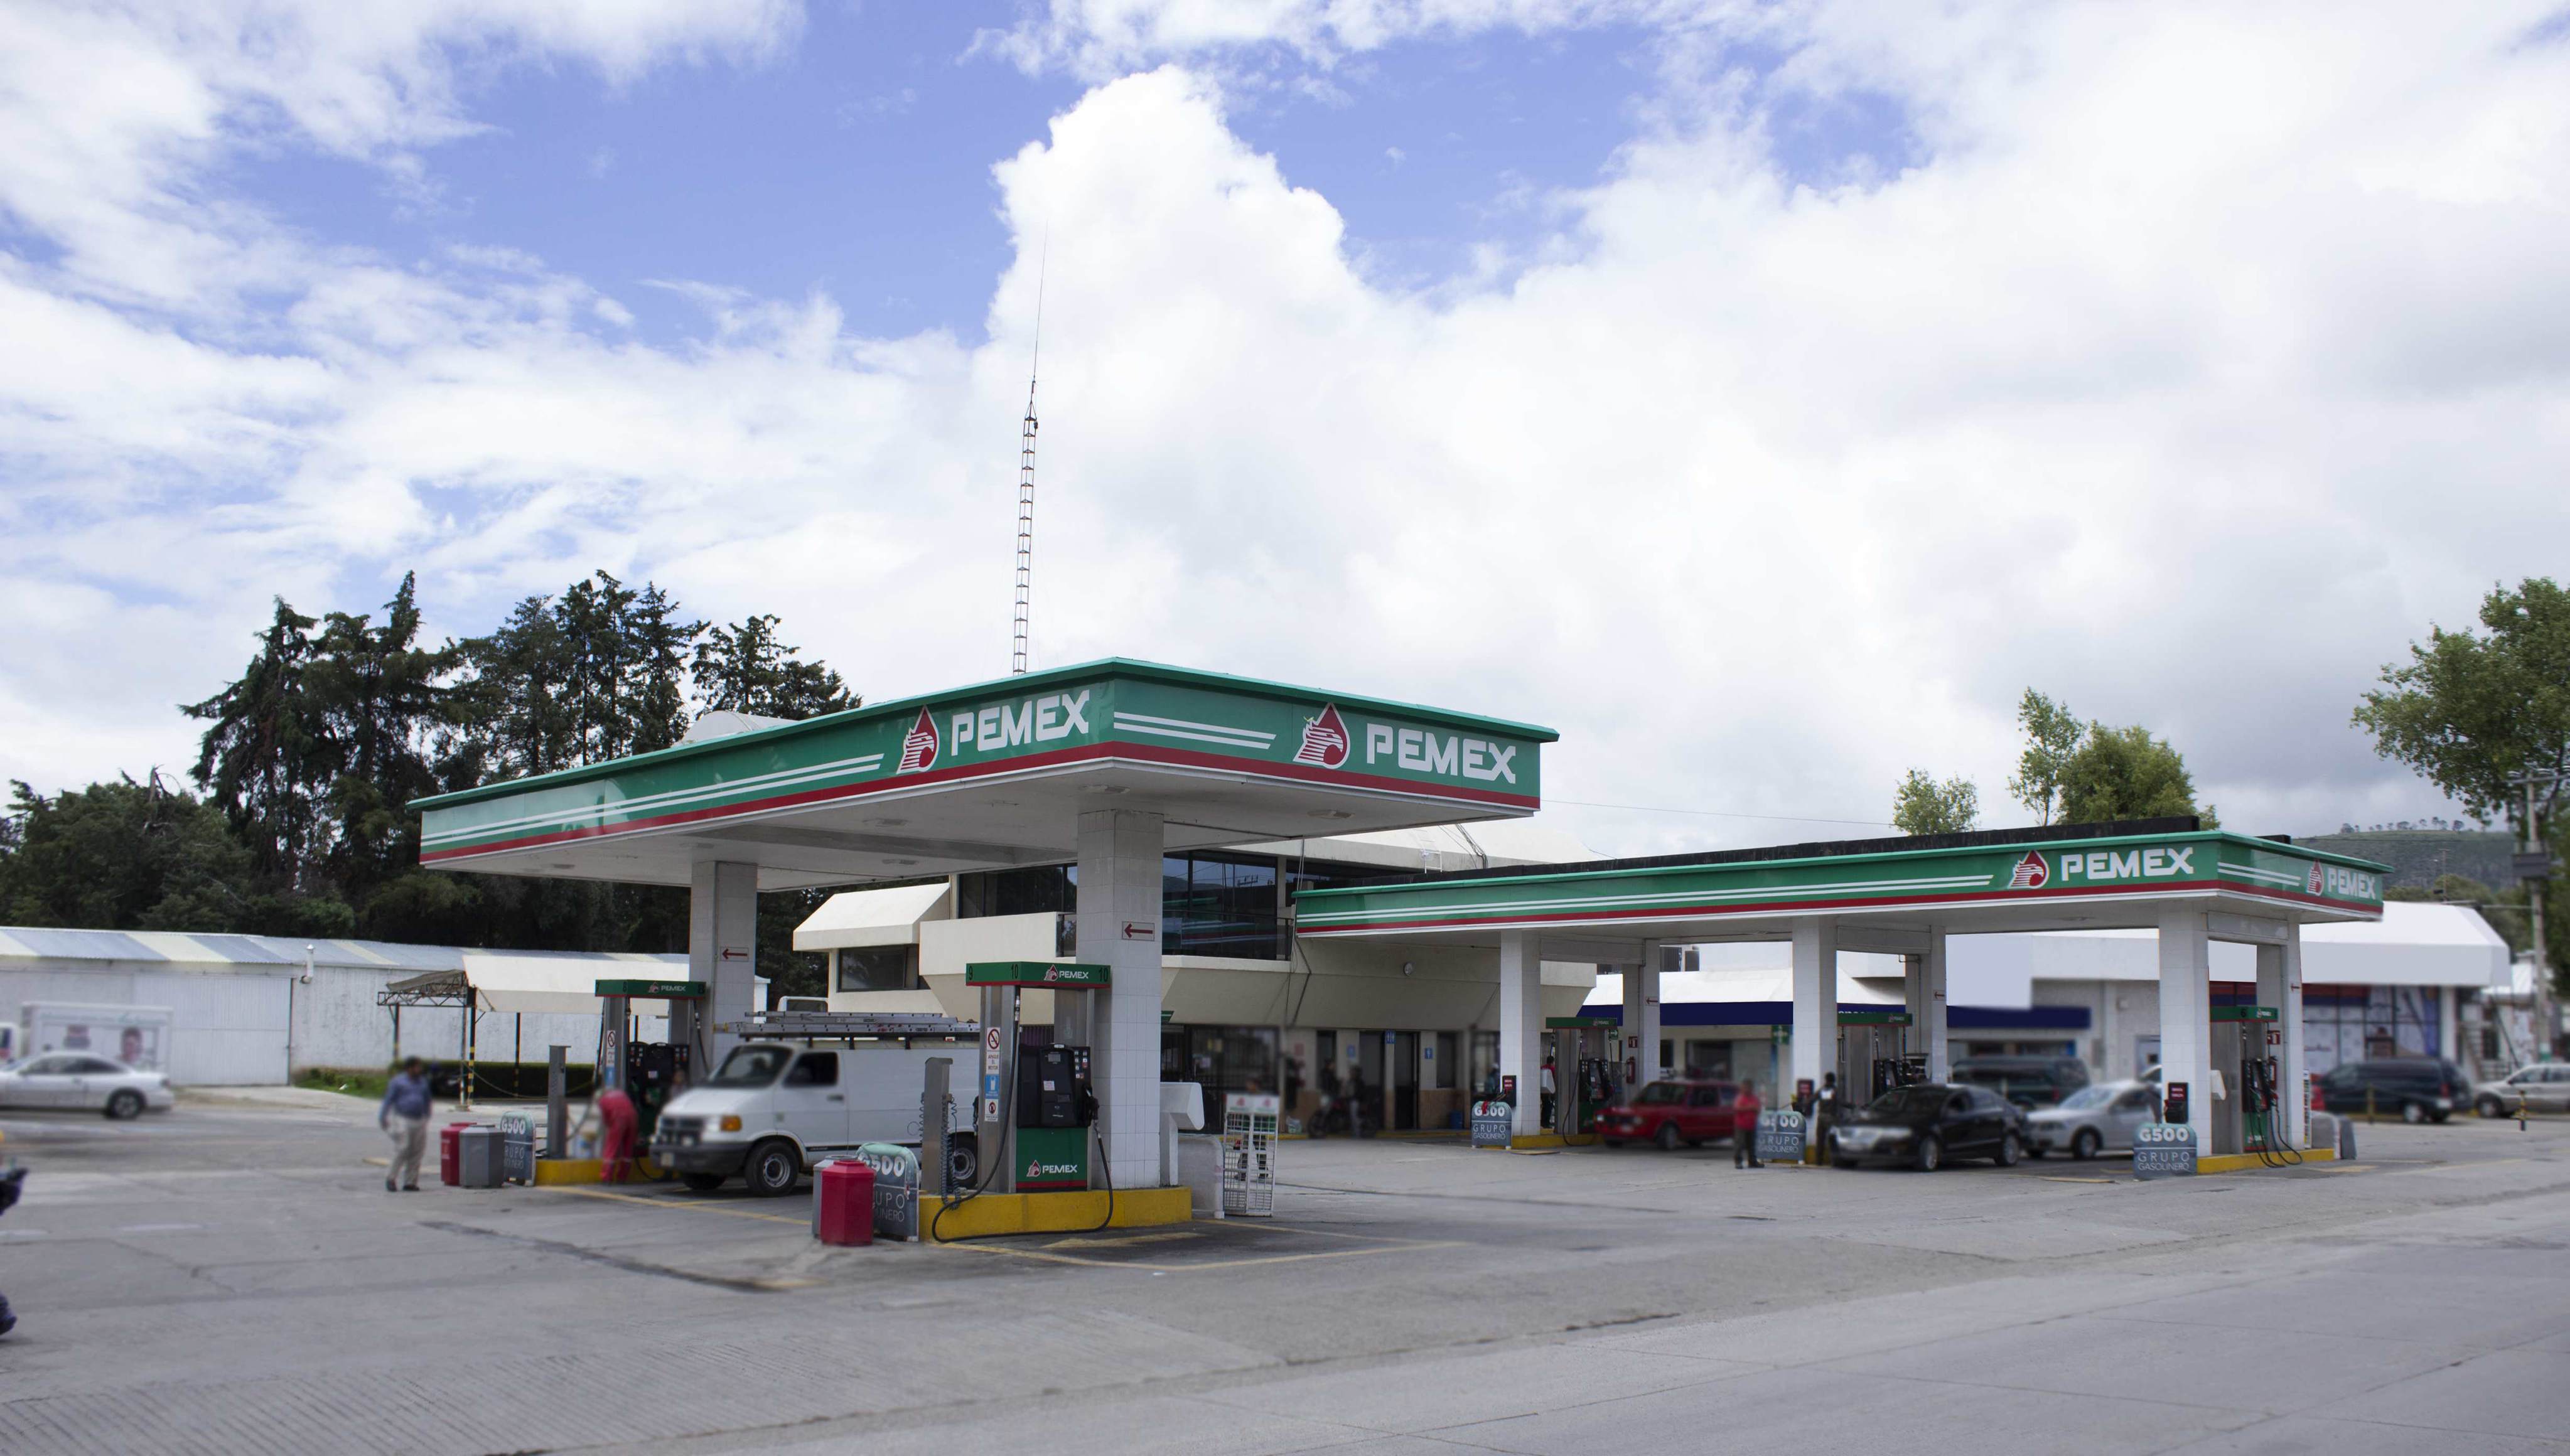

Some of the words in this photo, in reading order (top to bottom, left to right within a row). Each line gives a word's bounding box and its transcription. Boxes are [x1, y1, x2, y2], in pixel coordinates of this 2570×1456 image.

[951, 690, 1090, 756] PEMEX
[1367, 723, 1516, 784] PEMEX
[2061, 847, 2194, 881] PEMEX
[2327, 867, 2376, 899] PEMEX
[968, 965, 973, 980] 9
[1011, 963, 1019, 980] 10
[1059, 971, 1089, 979] PEMEX
[1099, 968, 1109, 982] 10
[502, 1118, 526, 1135] G500
[1473, 1125, 1506, 1133] GRUPO
[2139, 1127, 2190, 1142] G500
[504, 1145, 525, 1159] RUPO
[2138, 1152, 2190, 1162] GRUPO
[1042, 1165, 1078, 1174] PEMEX
[2138, 1162, 2190, 1171] GASOLINERO
